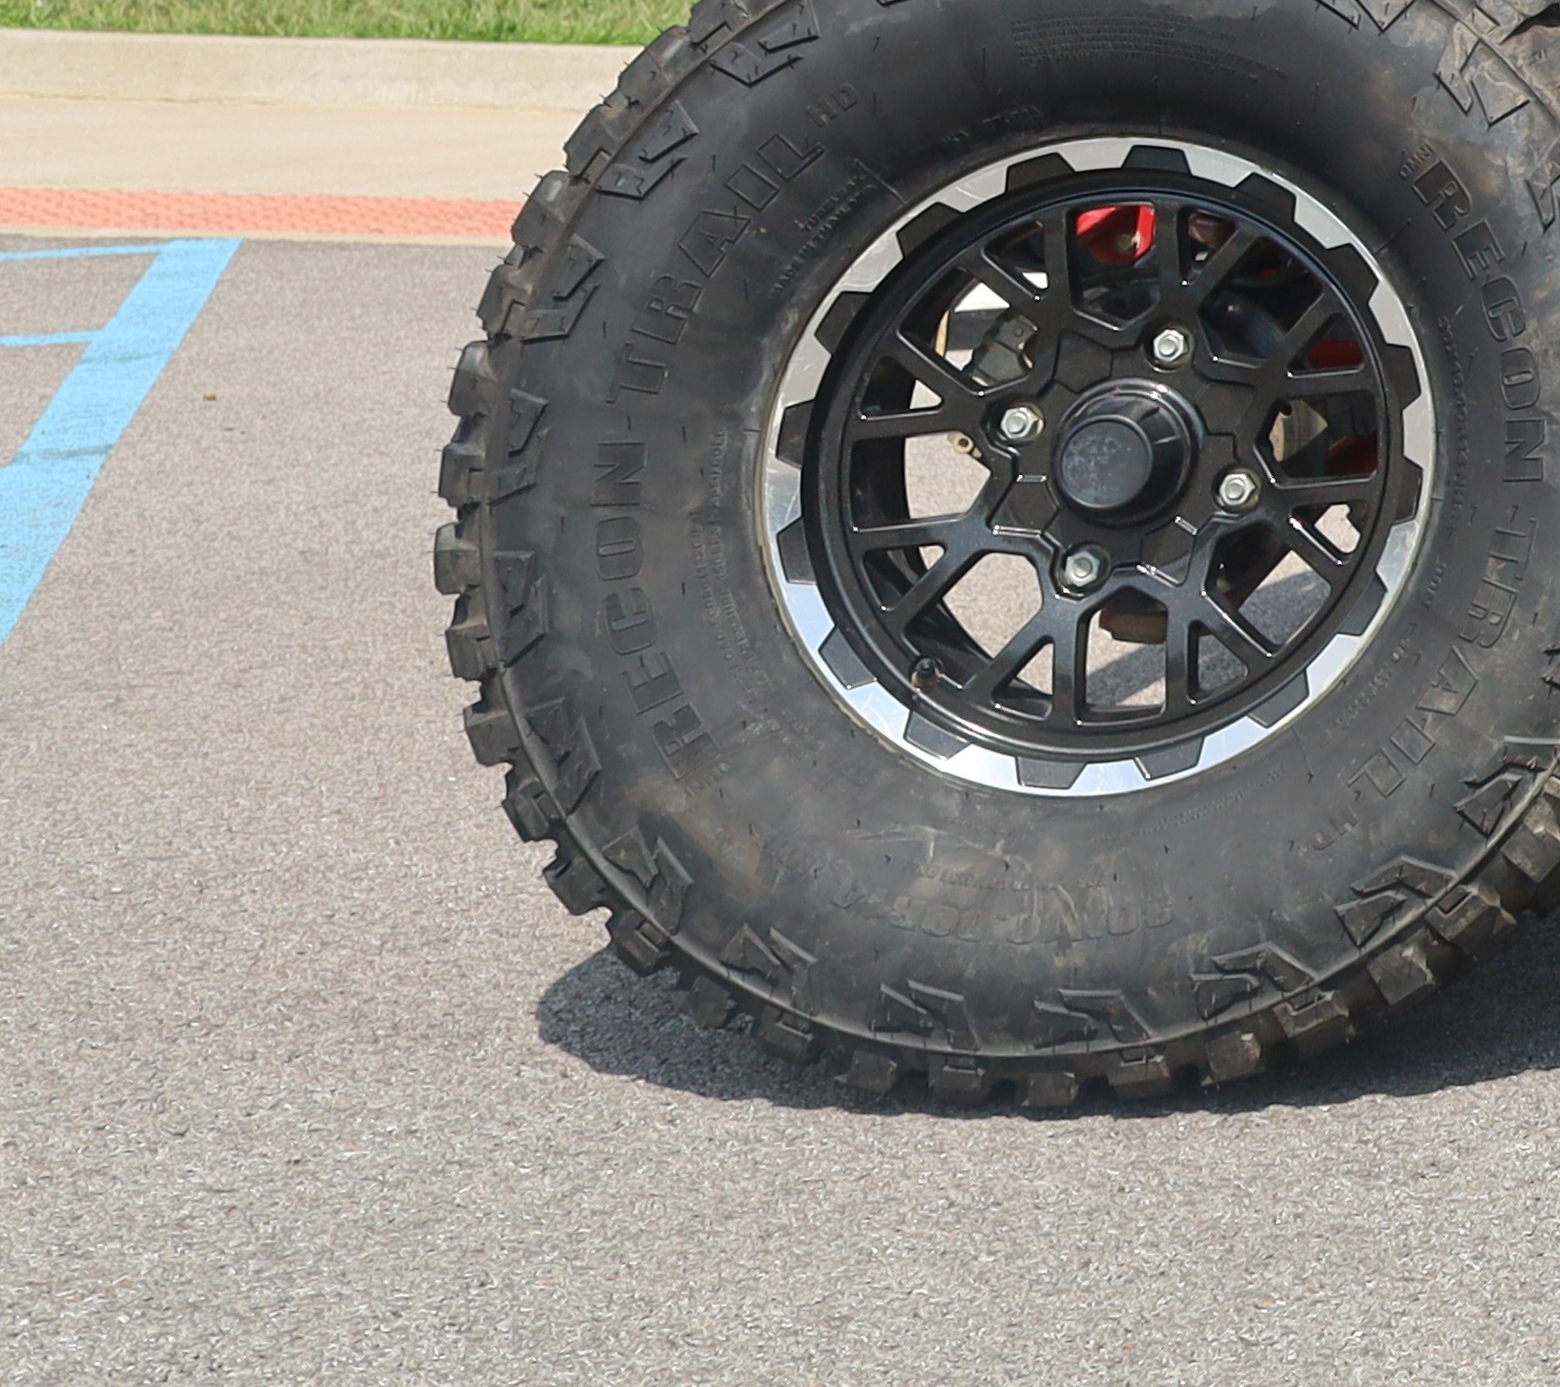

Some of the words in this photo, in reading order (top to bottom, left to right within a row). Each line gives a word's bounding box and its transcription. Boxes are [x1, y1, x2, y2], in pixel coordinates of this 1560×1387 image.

[804, 82, 860, 130] HD
[607, 132, 824, 405] TRAIL
[1414, 158, 1547, 485] RECON
[593, 441, 719, 782] RECON
[1343, 514, 1538, 805] TRAIL
